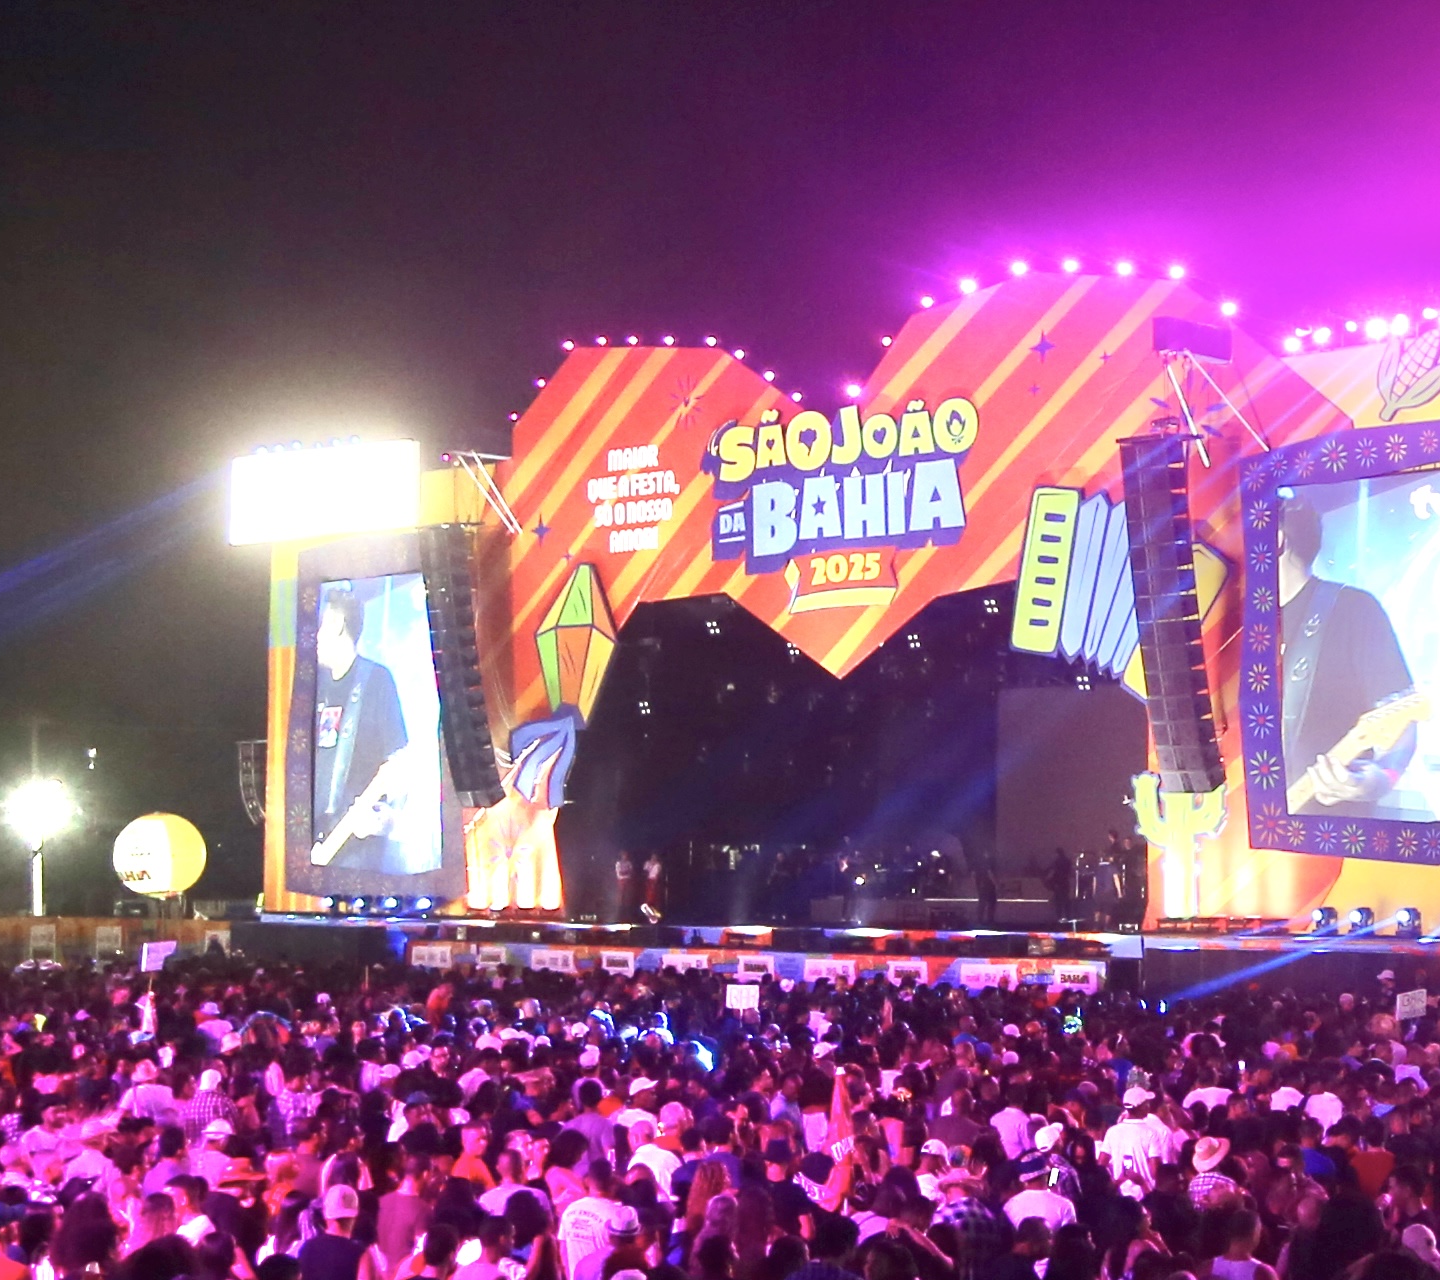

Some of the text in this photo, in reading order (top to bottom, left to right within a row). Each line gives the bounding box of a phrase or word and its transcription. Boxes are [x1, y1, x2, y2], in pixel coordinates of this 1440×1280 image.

[718, 398, 979, 482] SÃO JOÃO
[718, 458, 966, 557] DA BAHIA
[810, 552, 881, 586] 2025
